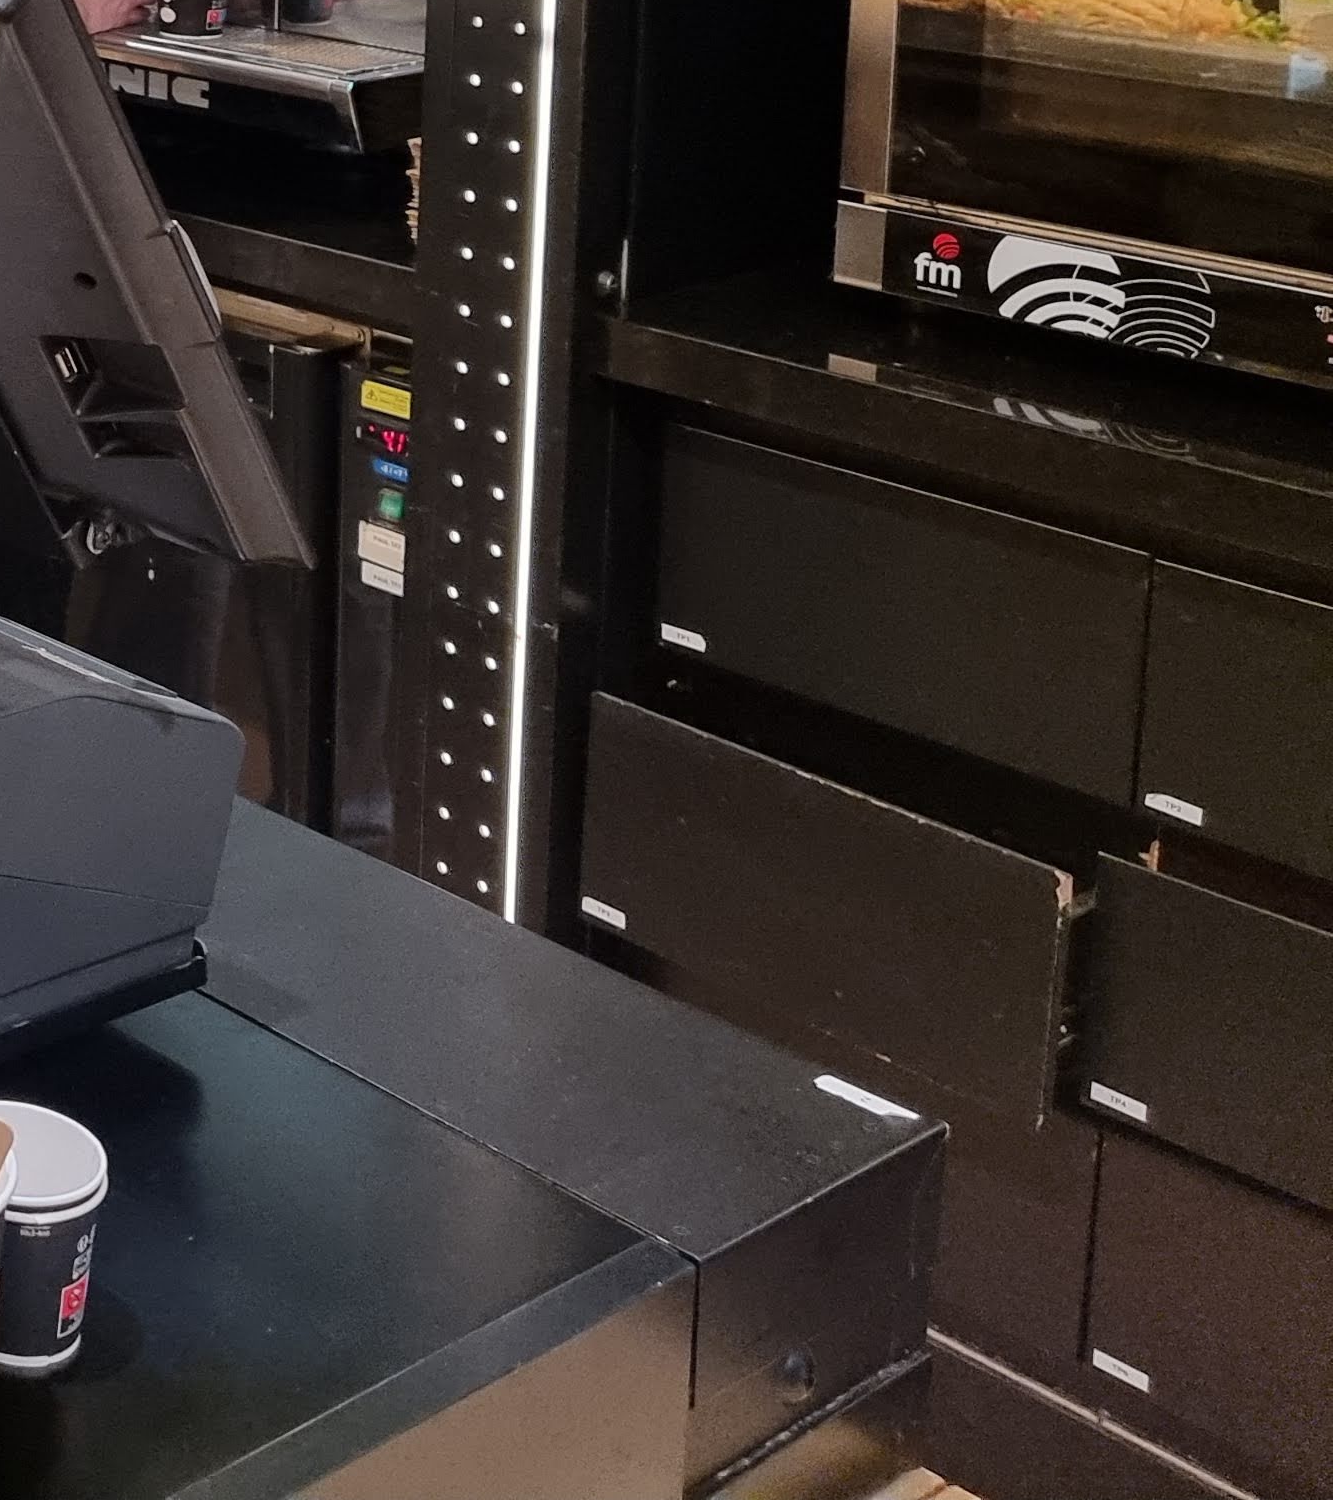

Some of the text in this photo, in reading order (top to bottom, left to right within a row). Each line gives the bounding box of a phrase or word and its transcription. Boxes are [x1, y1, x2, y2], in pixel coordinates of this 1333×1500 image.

[102, 62, 210, 109] NIC
[914, 251, 962, 290] fm
[1164, 800, 1182, 813] TP2
[1109, 1095, 1127, 1108] TP4
